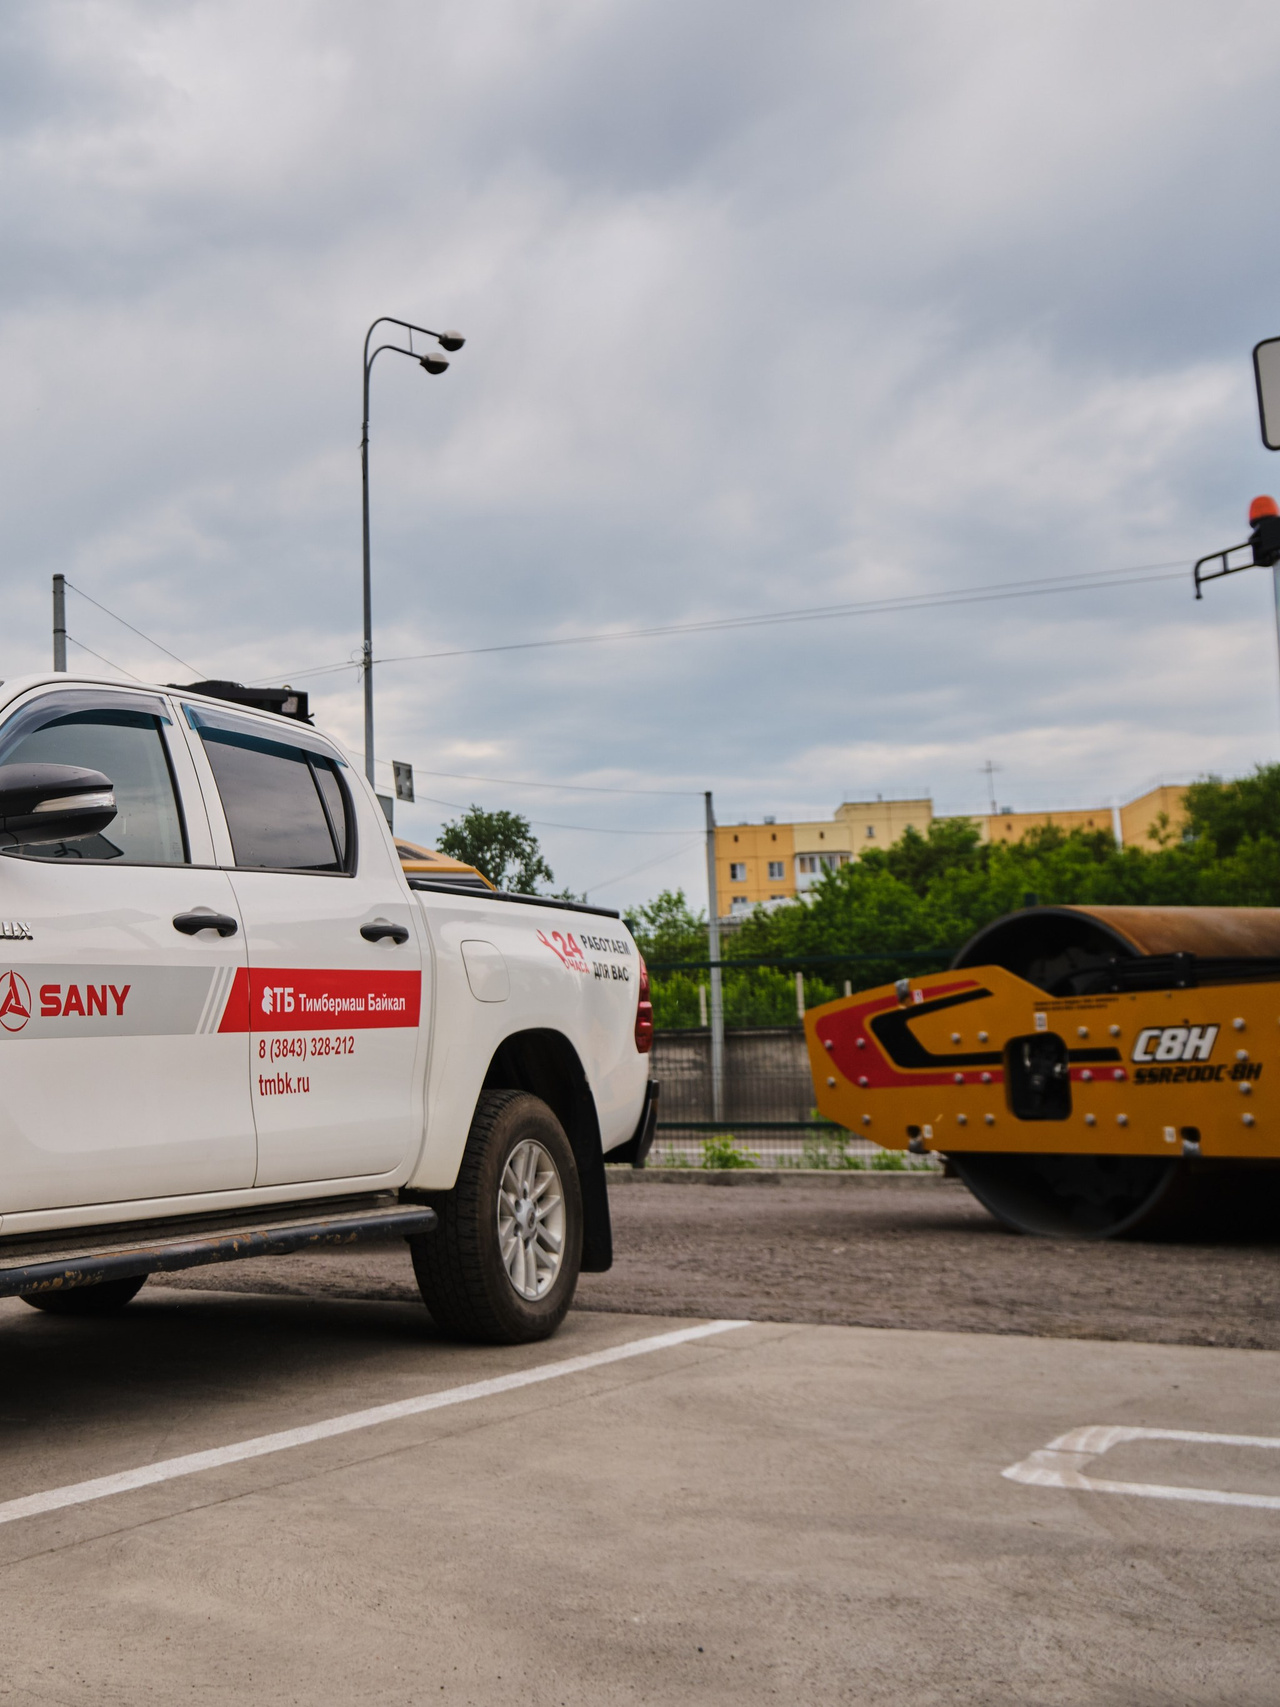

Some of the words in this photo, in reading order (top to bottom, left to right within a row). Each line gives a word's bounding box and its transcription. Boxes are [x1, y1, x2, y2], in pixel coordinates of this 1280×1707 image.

[551, 930, 584, 960] 24
[580, 934, 631, 955] РАБОТАЕМ
[592, 961, 610, 980] ДЛЯ
[611, 964, 629, 981] ВАС
[39, 984, 131, 1017] SANY
[299, 993, 365, 1016] Тимбермаш
[367, 993, 406, 1012] Байкал
[258, 1039, 266, 1059] 8
[270, 1037, 307, 1063] (3843)
[310, 1035, 355, 1057] 328-212
[258, 1071, 310, 1097] tmbk.ru
